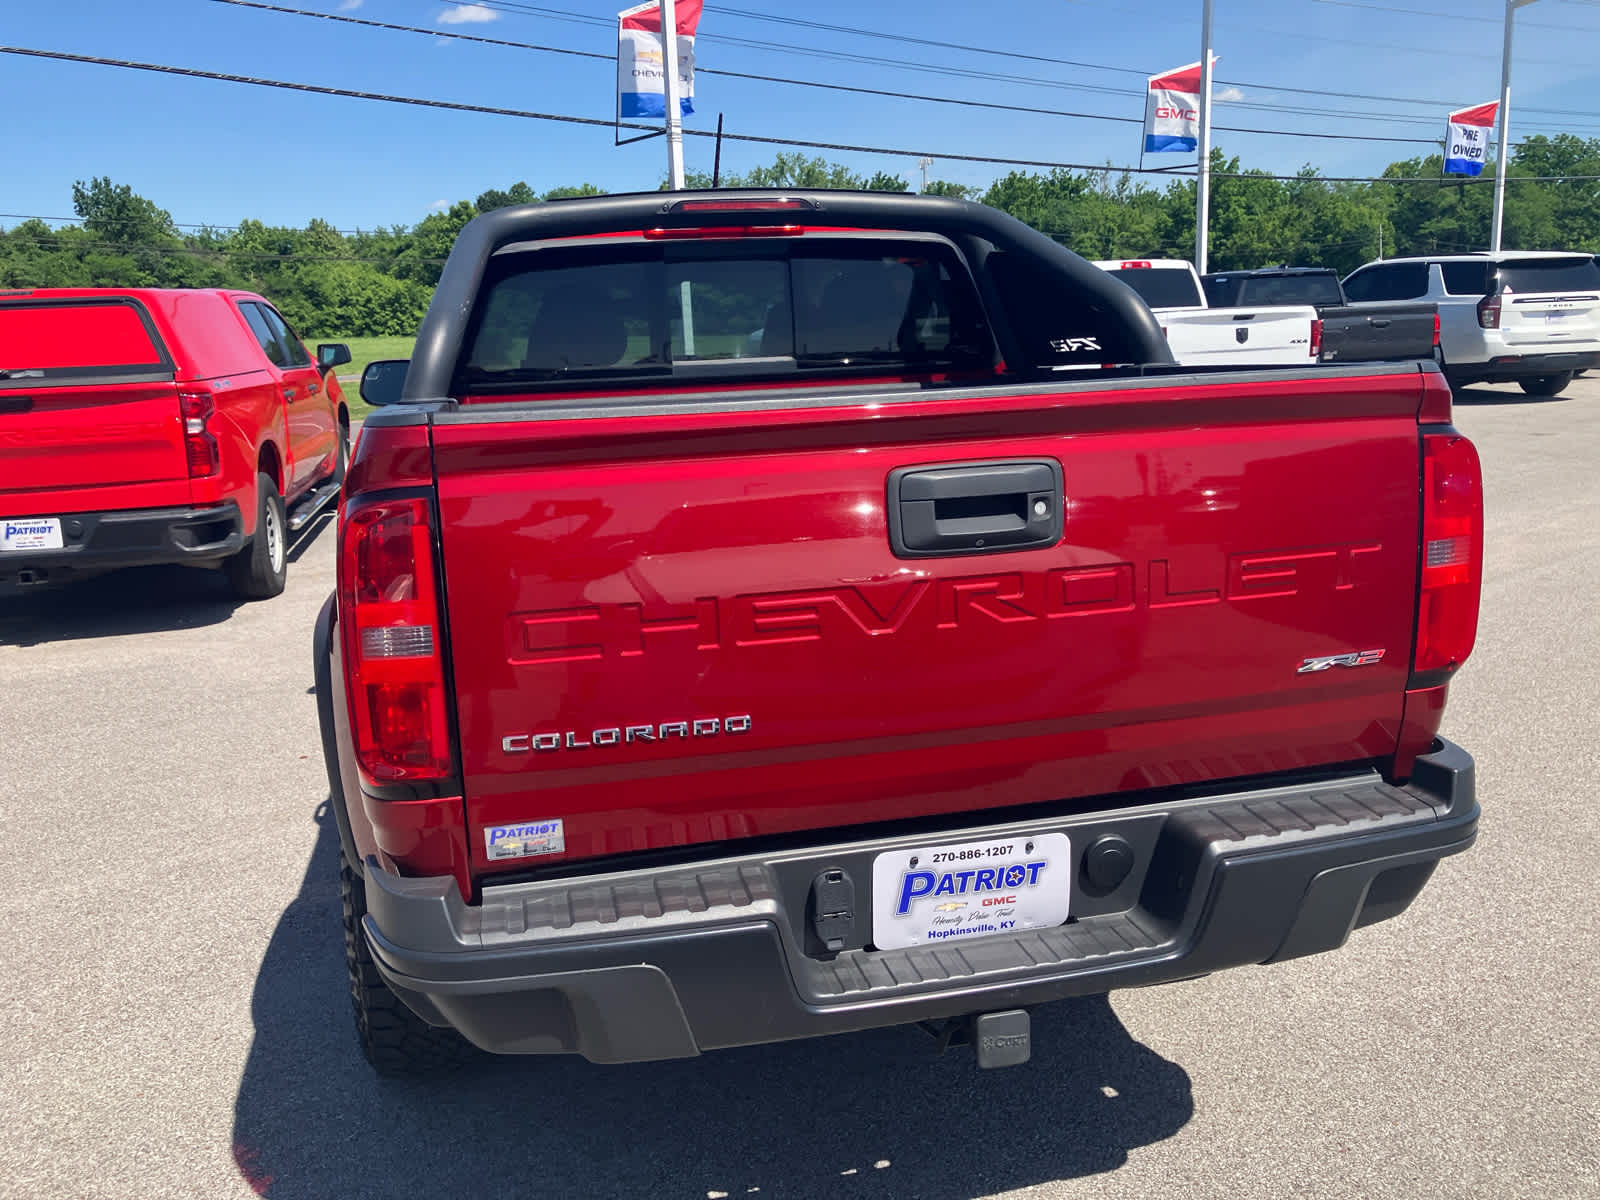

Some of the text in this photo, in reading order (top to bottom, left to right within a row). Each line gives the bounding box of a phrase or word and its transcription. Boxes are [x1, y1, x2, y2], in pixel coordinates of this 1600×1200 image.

[1155, 107, 1197, 122] GMC
[1462, 128, 1479, 141] PRE
[1452, 144, 1482, 158] OWNED
[5, 525, 54, 540] PATRIOT
[507, 539, 1382, 666] CHEVROLET
[1297, 648, 1386, 673] ZR2
[502, 714, 752, 752] COLORADO
[490, 823, 558, 846] PATRIOT
[932, 845, 1014, 863] 270-886-1207
[896, 861, 1047, 915] PATRIOT
[982, 895, 1017, 907] GMC
[928, 923, 997, 939] Hopkinsville,
[1000, 920, 1016, 929] KY
